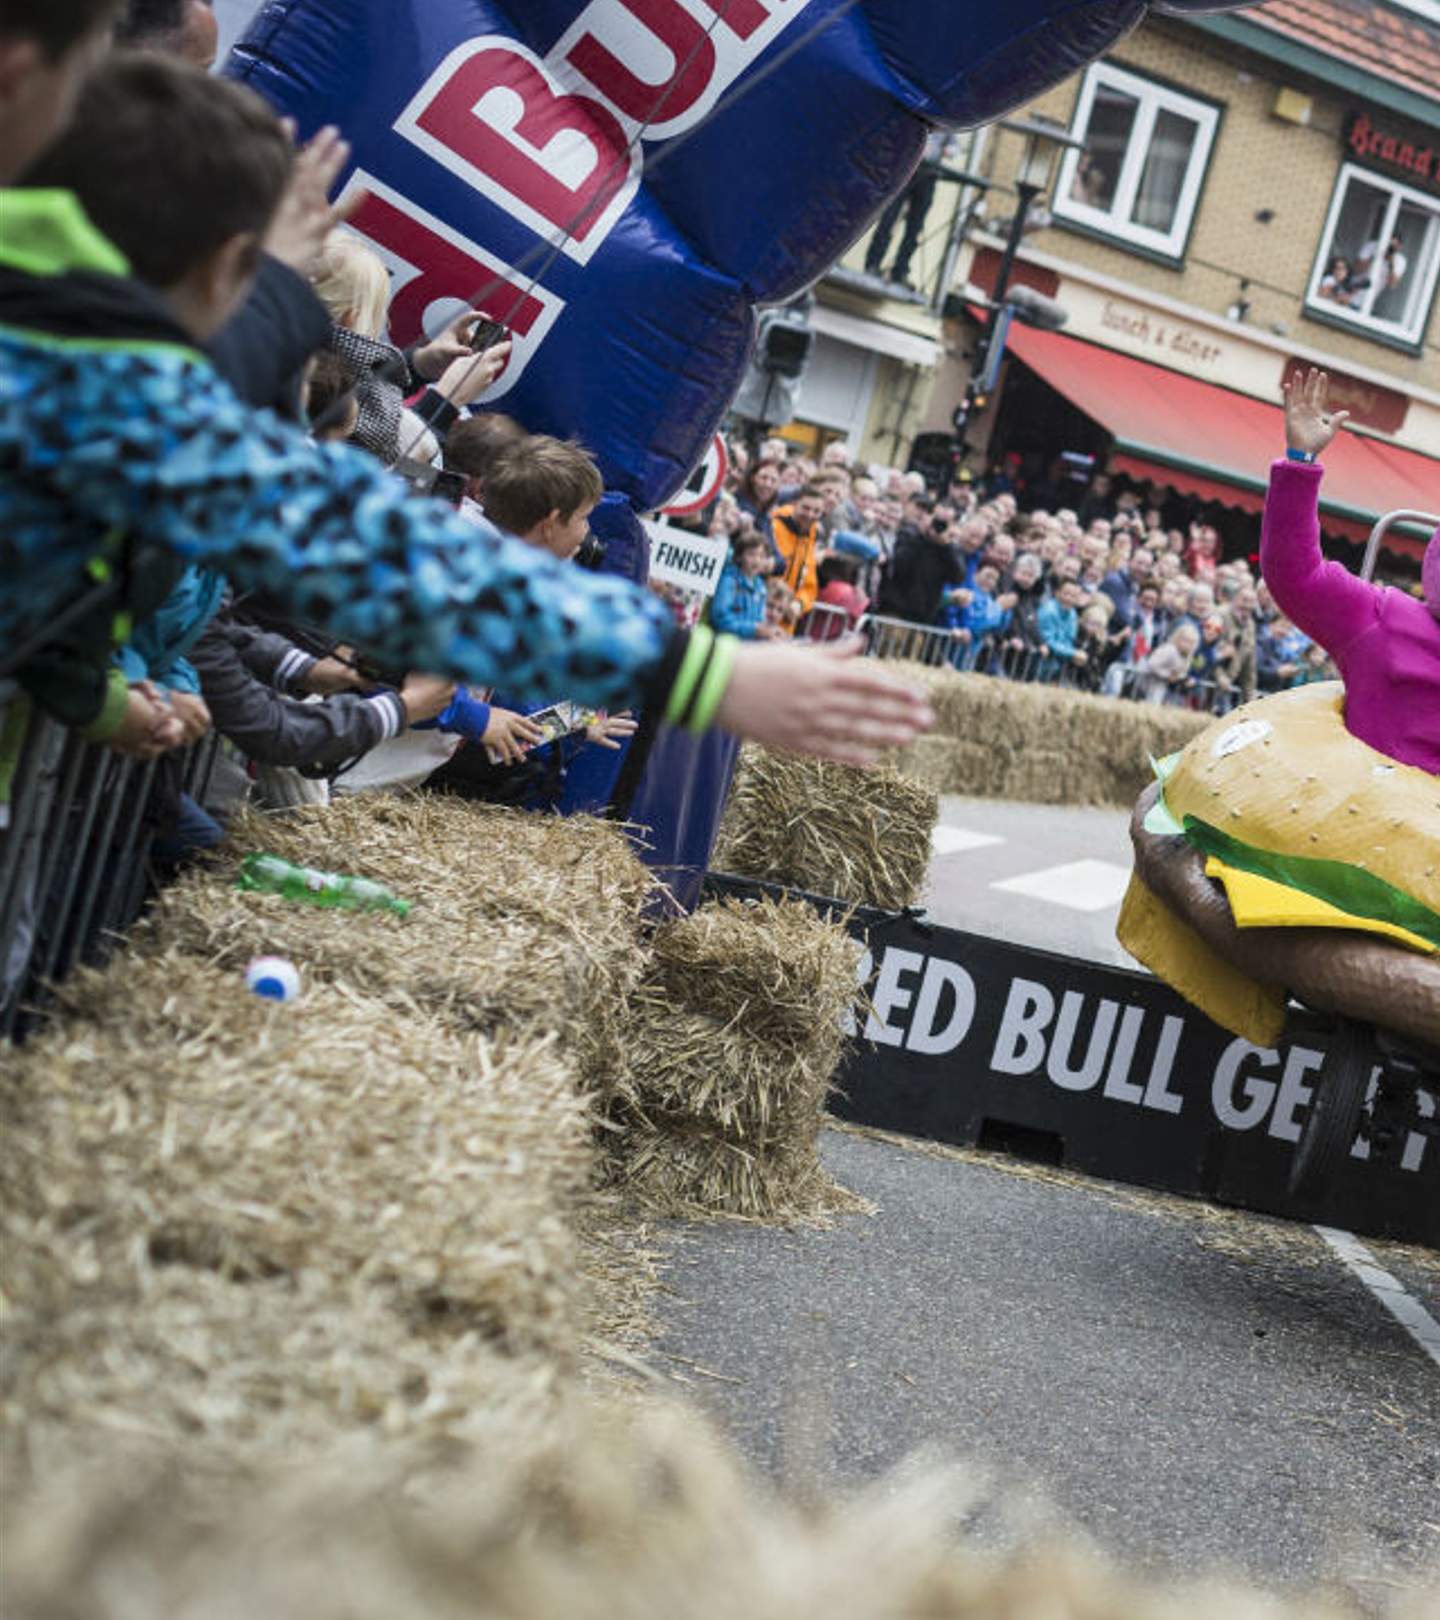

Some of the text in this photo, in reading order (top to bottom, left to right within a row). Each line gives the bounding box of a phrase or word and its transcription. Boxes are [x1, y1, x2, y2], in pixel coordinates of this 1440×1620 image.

[415, 0, 792, 244] Bu
[655, 541, 718, 580] FINISH
[989, 976, 1184, 1114] BULL
